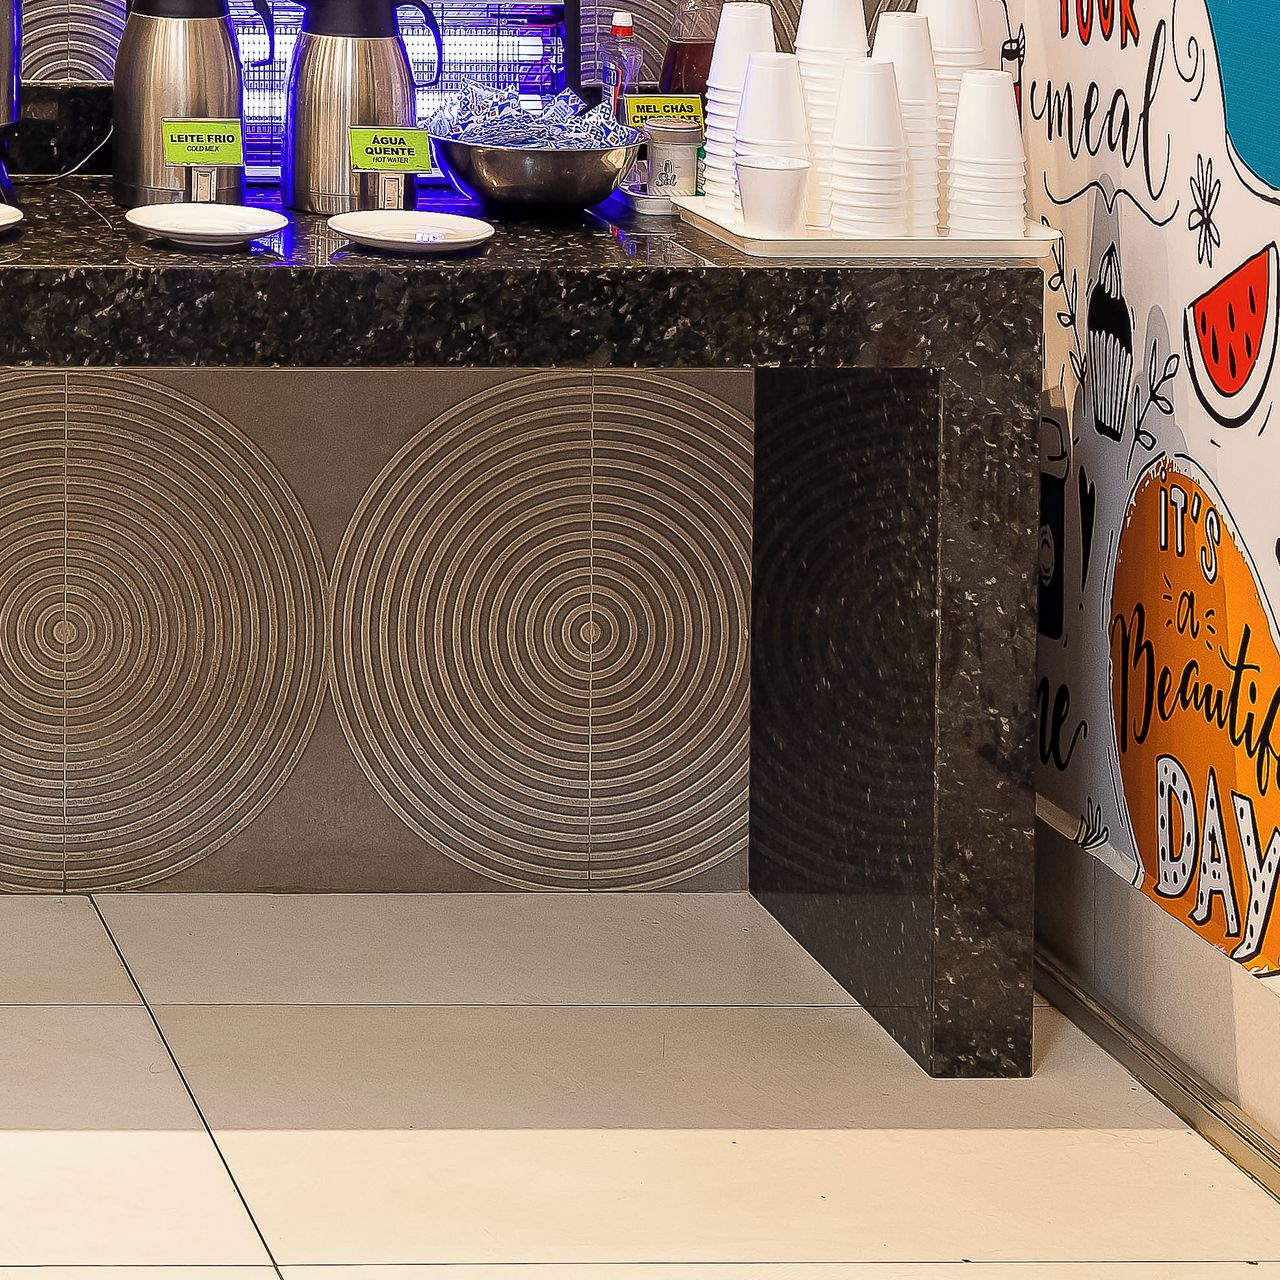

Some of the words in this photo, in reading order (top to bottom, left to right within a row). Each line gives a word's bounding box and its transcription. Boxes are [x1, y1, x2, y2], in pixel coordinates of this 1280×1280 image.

[636, 105, 660, 113] MEL
[663, 103, 694, 113] CHÁS
[1030, 19, 1170, 201] meal
[170, 134, 204, 143] LEITE
[207, 134, 235, 143] FRIO
[365, 147, 415, 156] QUENTE
[372, 135, 406, 145] ÁGUA
[1176, 590, 1200, 640] a
[1110, 602, 1280, 797] Beautif
[1153, 754, 1280, 964] DAY
